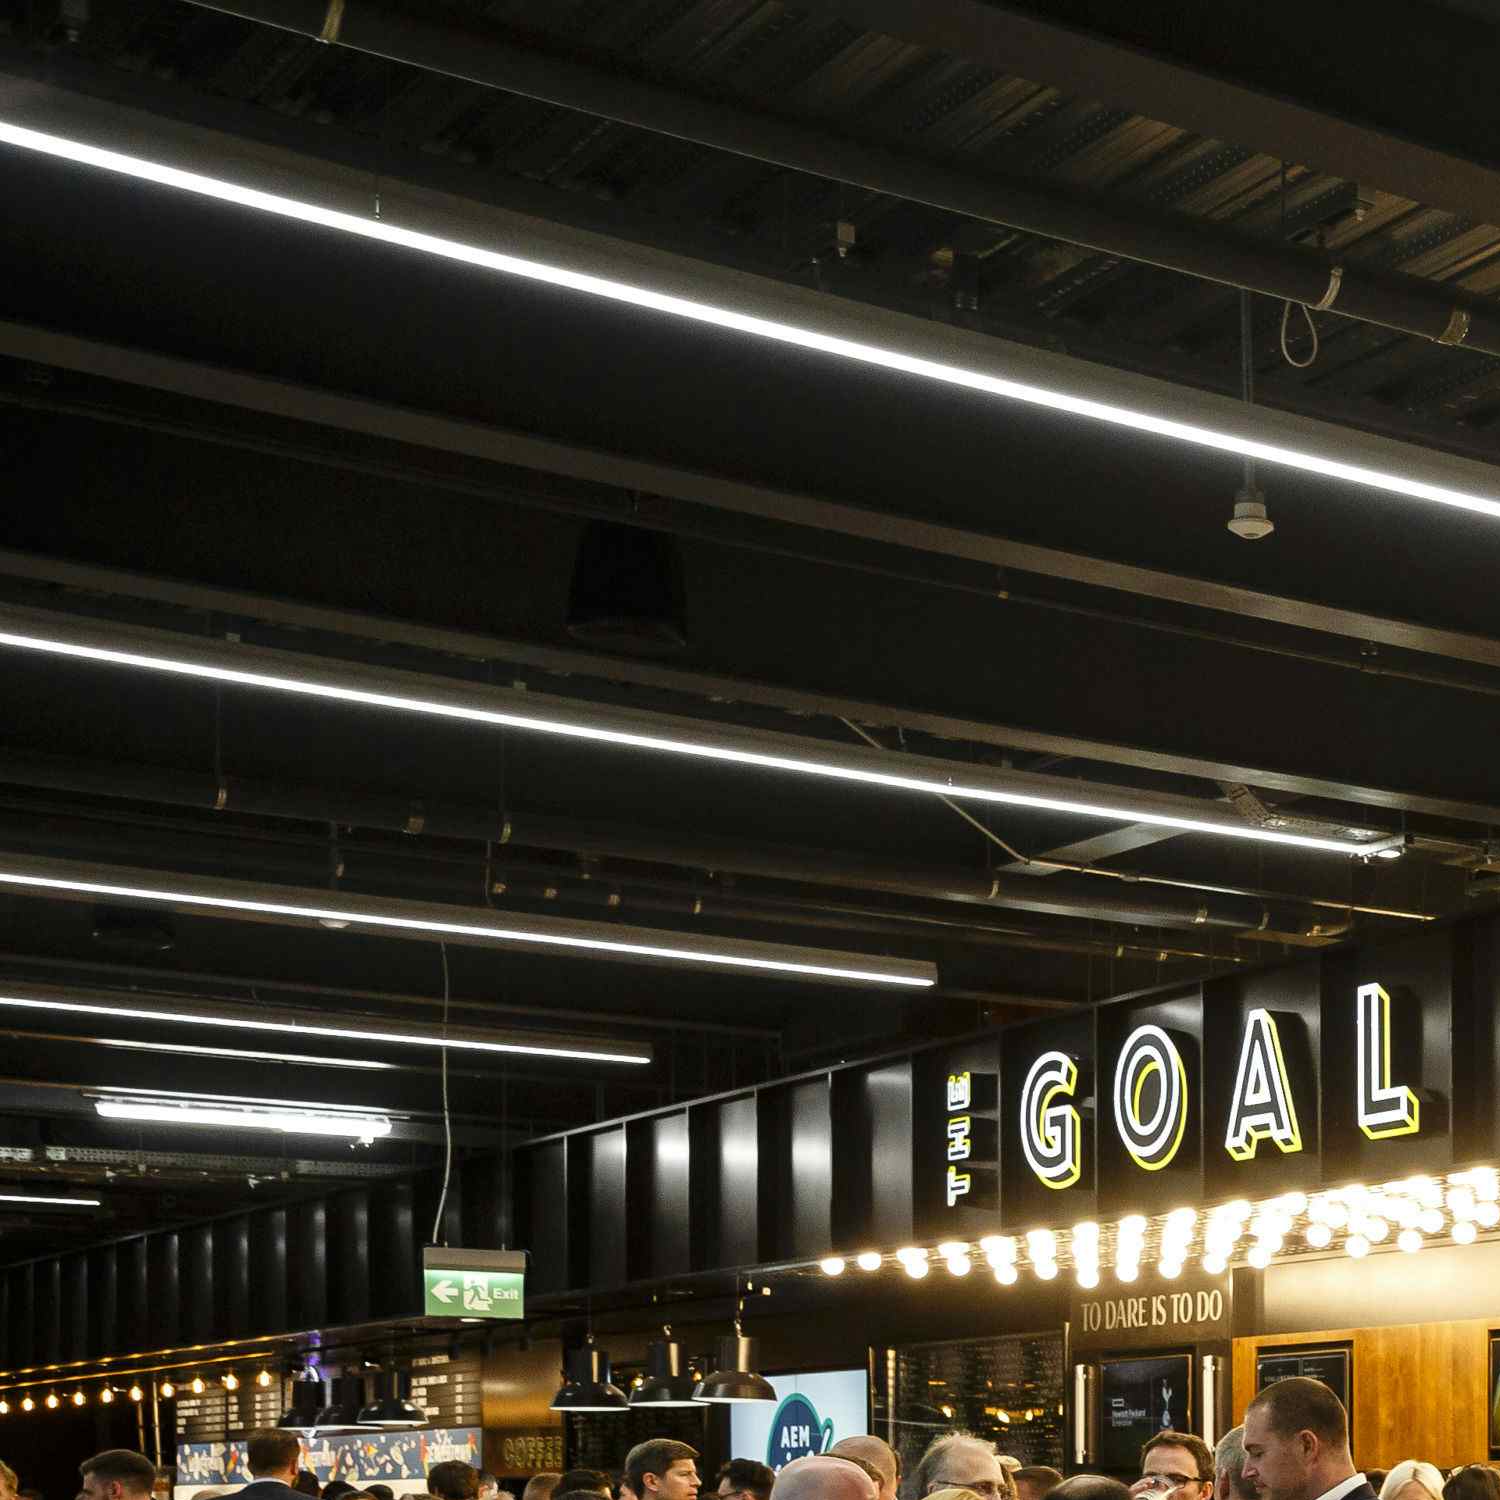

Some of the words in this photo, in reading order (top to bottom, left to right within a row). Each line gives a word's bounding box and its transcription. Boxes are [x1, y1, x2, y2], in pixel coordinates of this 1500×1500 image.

[947, 1071, 971, 1207] THE
[1020, 982, 1419, 1189] GOAL
[493, 1287, 519, 1300] Exit
[1081, 1302, 1101, 1332] TO
[1105, 1297, 1148, 1330] DARE
[1152, 1294, 1167, 1326] IS
[1170, 1292, 1193, 1324] TO
[1197, 1289, 1223, 1322] DO
[504, 1435, 563, 1469] COFFEE
[780, 1424, 810, 1448] AEM
